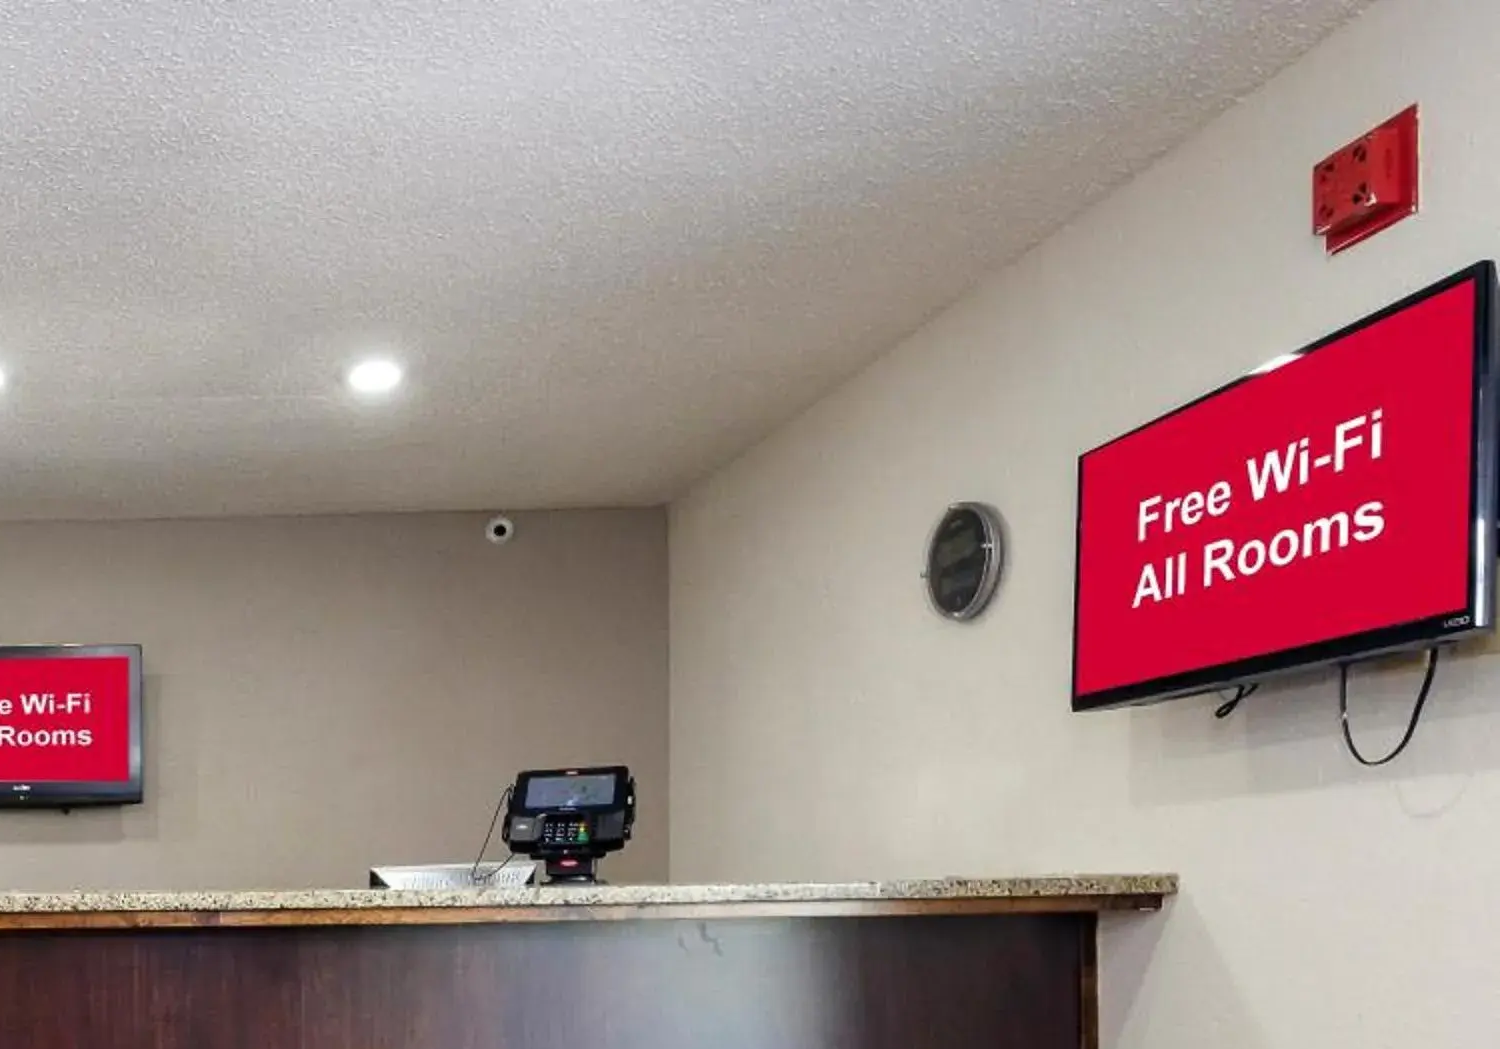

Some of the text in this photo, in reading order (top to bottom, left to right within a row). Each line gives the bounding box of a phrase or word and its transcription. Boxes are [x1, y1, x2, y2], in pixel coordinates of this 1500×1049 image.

[1138, 408, 1383, 542] Free Wi-Fi
[1132, 501, 1385, 609] All Rooms
[20, 693, 91, 715] Wi-Fi
